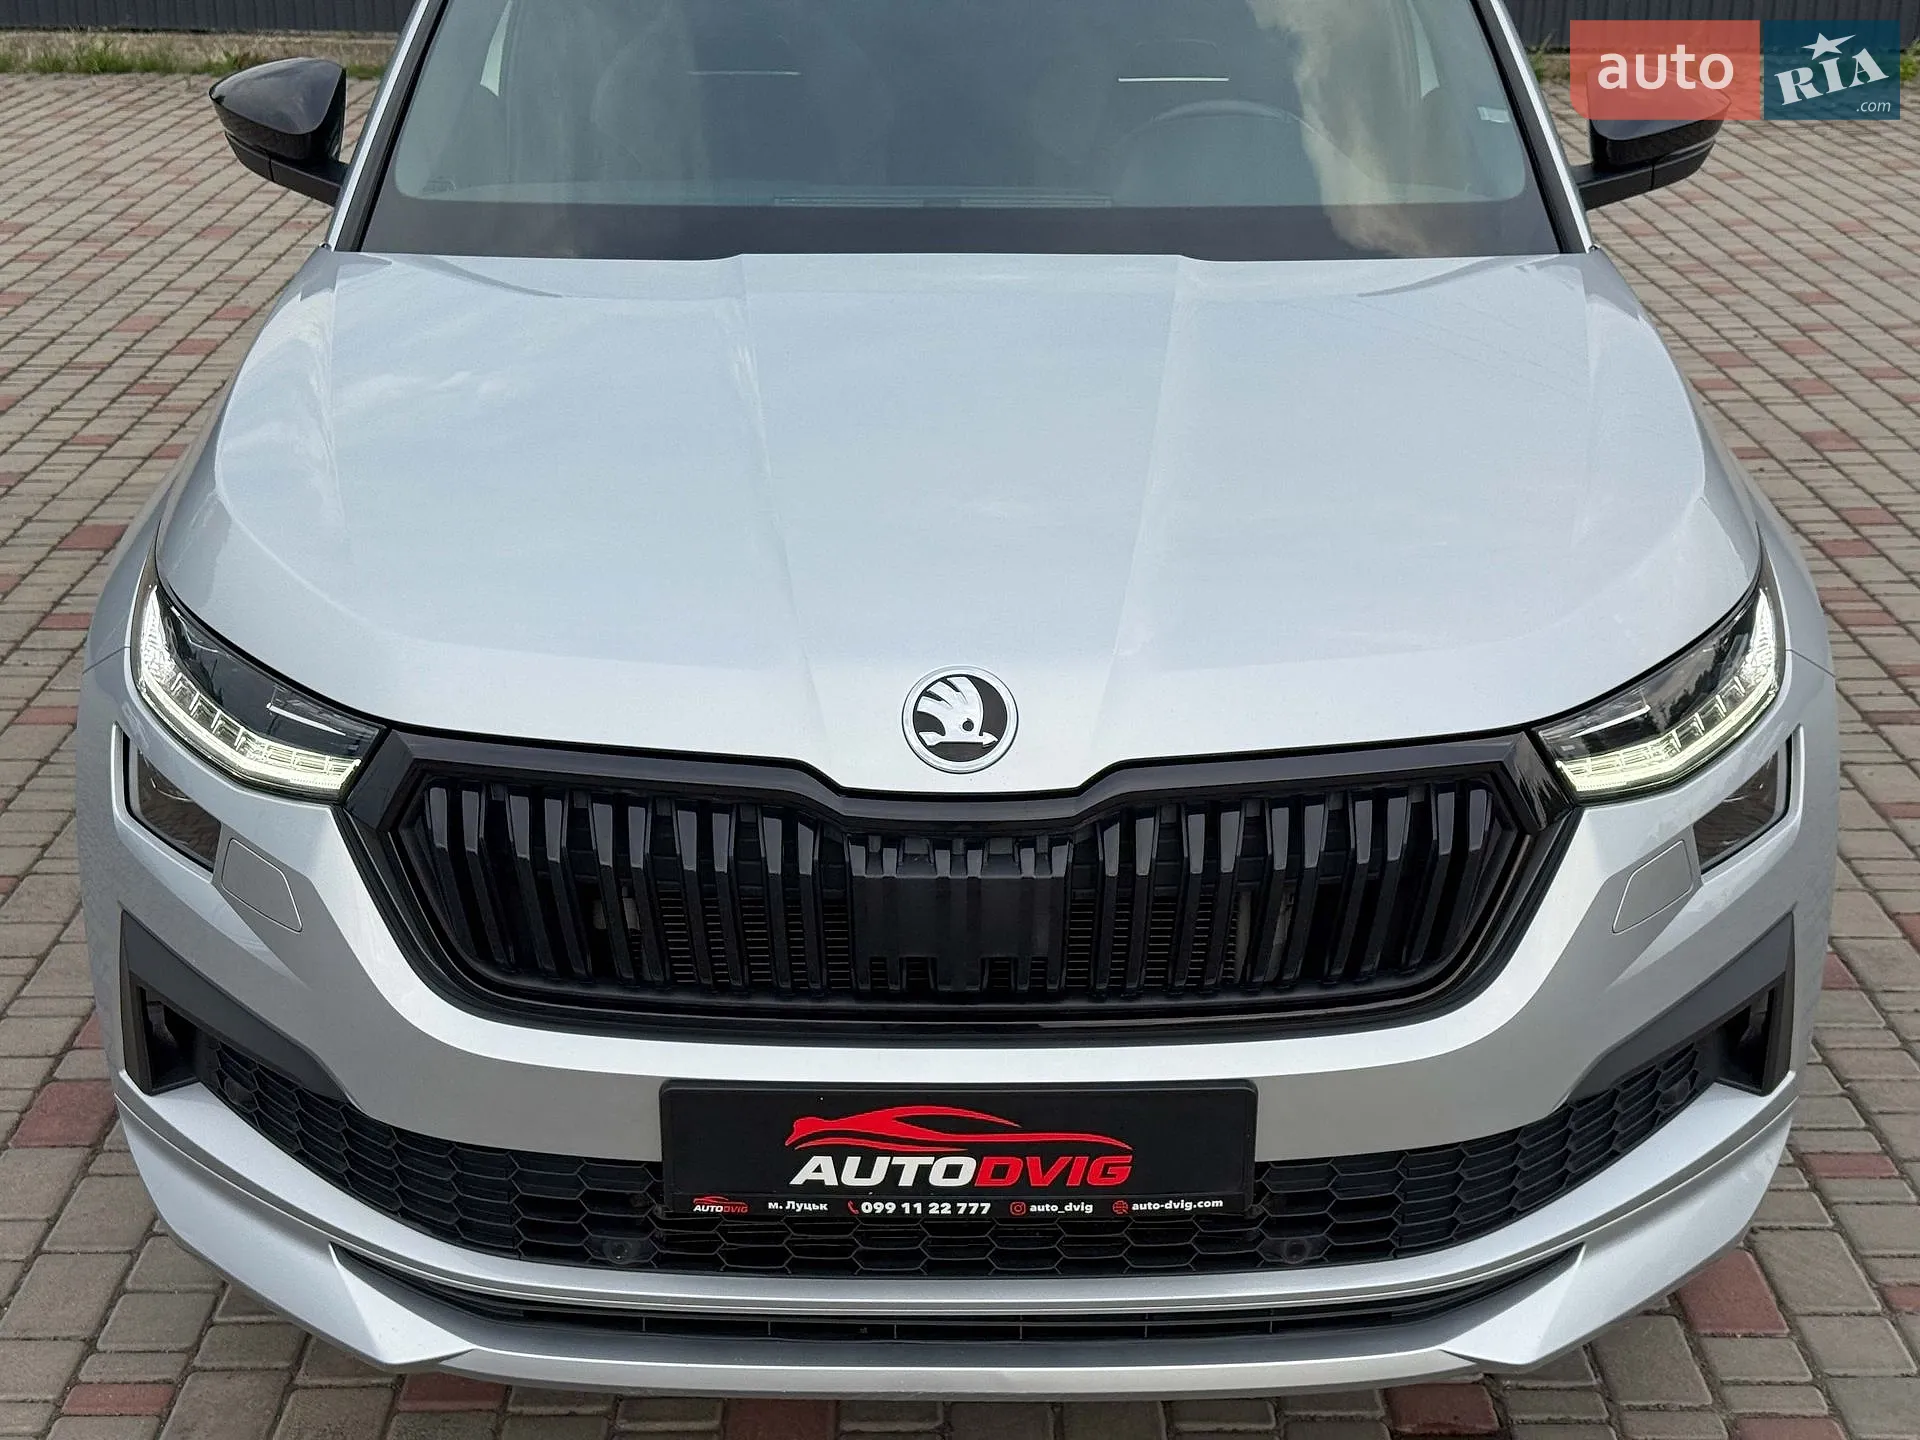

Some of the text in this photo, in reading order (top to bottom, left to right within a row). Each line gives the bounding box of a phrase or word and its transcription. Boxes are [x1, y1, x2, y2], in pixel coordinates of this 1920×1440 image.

[789, 1155, 1132, 1187] AUTODVIG
[786, 1200, 828, 1213] Луцьк
[861, 1202, 991, 1215] 099 11 22 777
[1029, 1201, 1093, 1214] auto_dvig
[1132, 1198, 1223, 1213] auto-dvig.com
